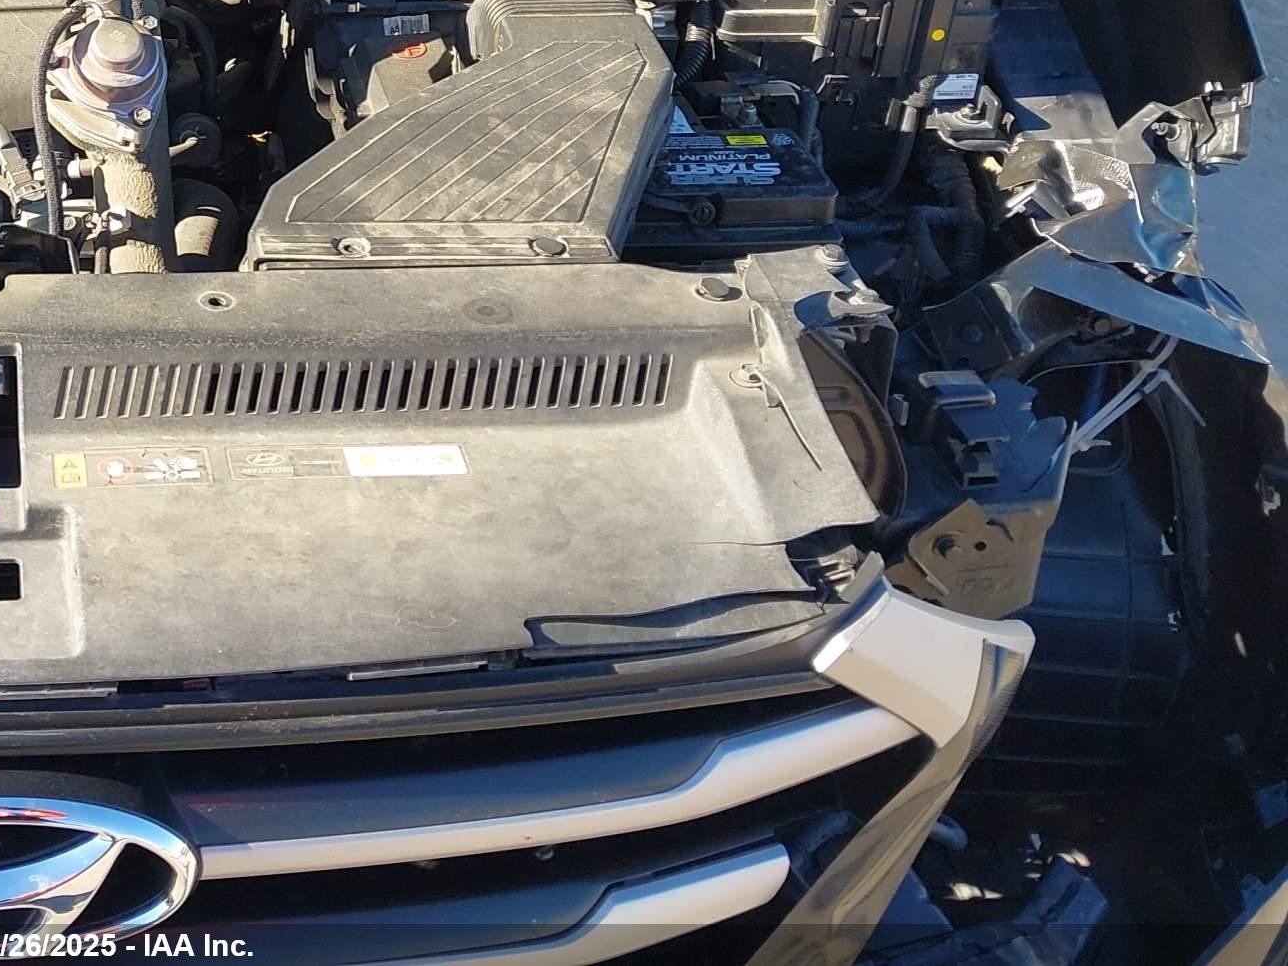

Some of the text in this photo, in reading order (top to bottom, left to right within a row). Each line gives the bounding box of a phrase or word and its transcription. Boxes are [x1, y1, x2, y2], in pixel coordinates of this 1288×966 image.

[679, 153, 772, 161] PLATINUM
[666, 162, 781, 176] START
[670, 174, 775, 185] SUPER
